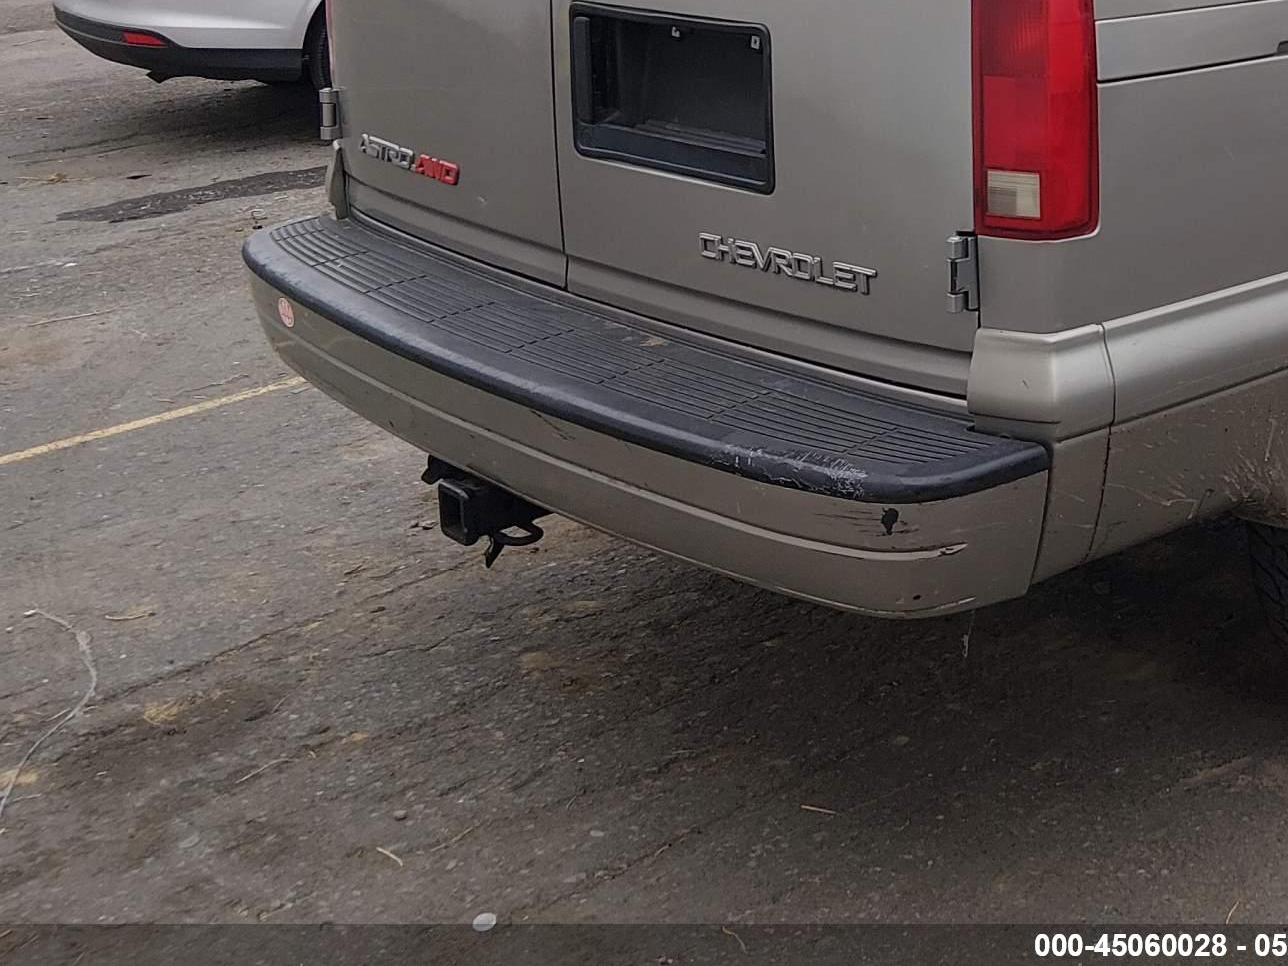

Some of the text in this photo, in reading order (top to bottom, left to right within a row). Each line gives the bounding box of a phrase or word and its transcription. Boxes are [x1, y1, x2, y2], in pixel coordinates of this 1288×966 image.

[360, 133, 459, 186] ASTRO AWD
[698, 232, 878, 295] CHEVROLET
